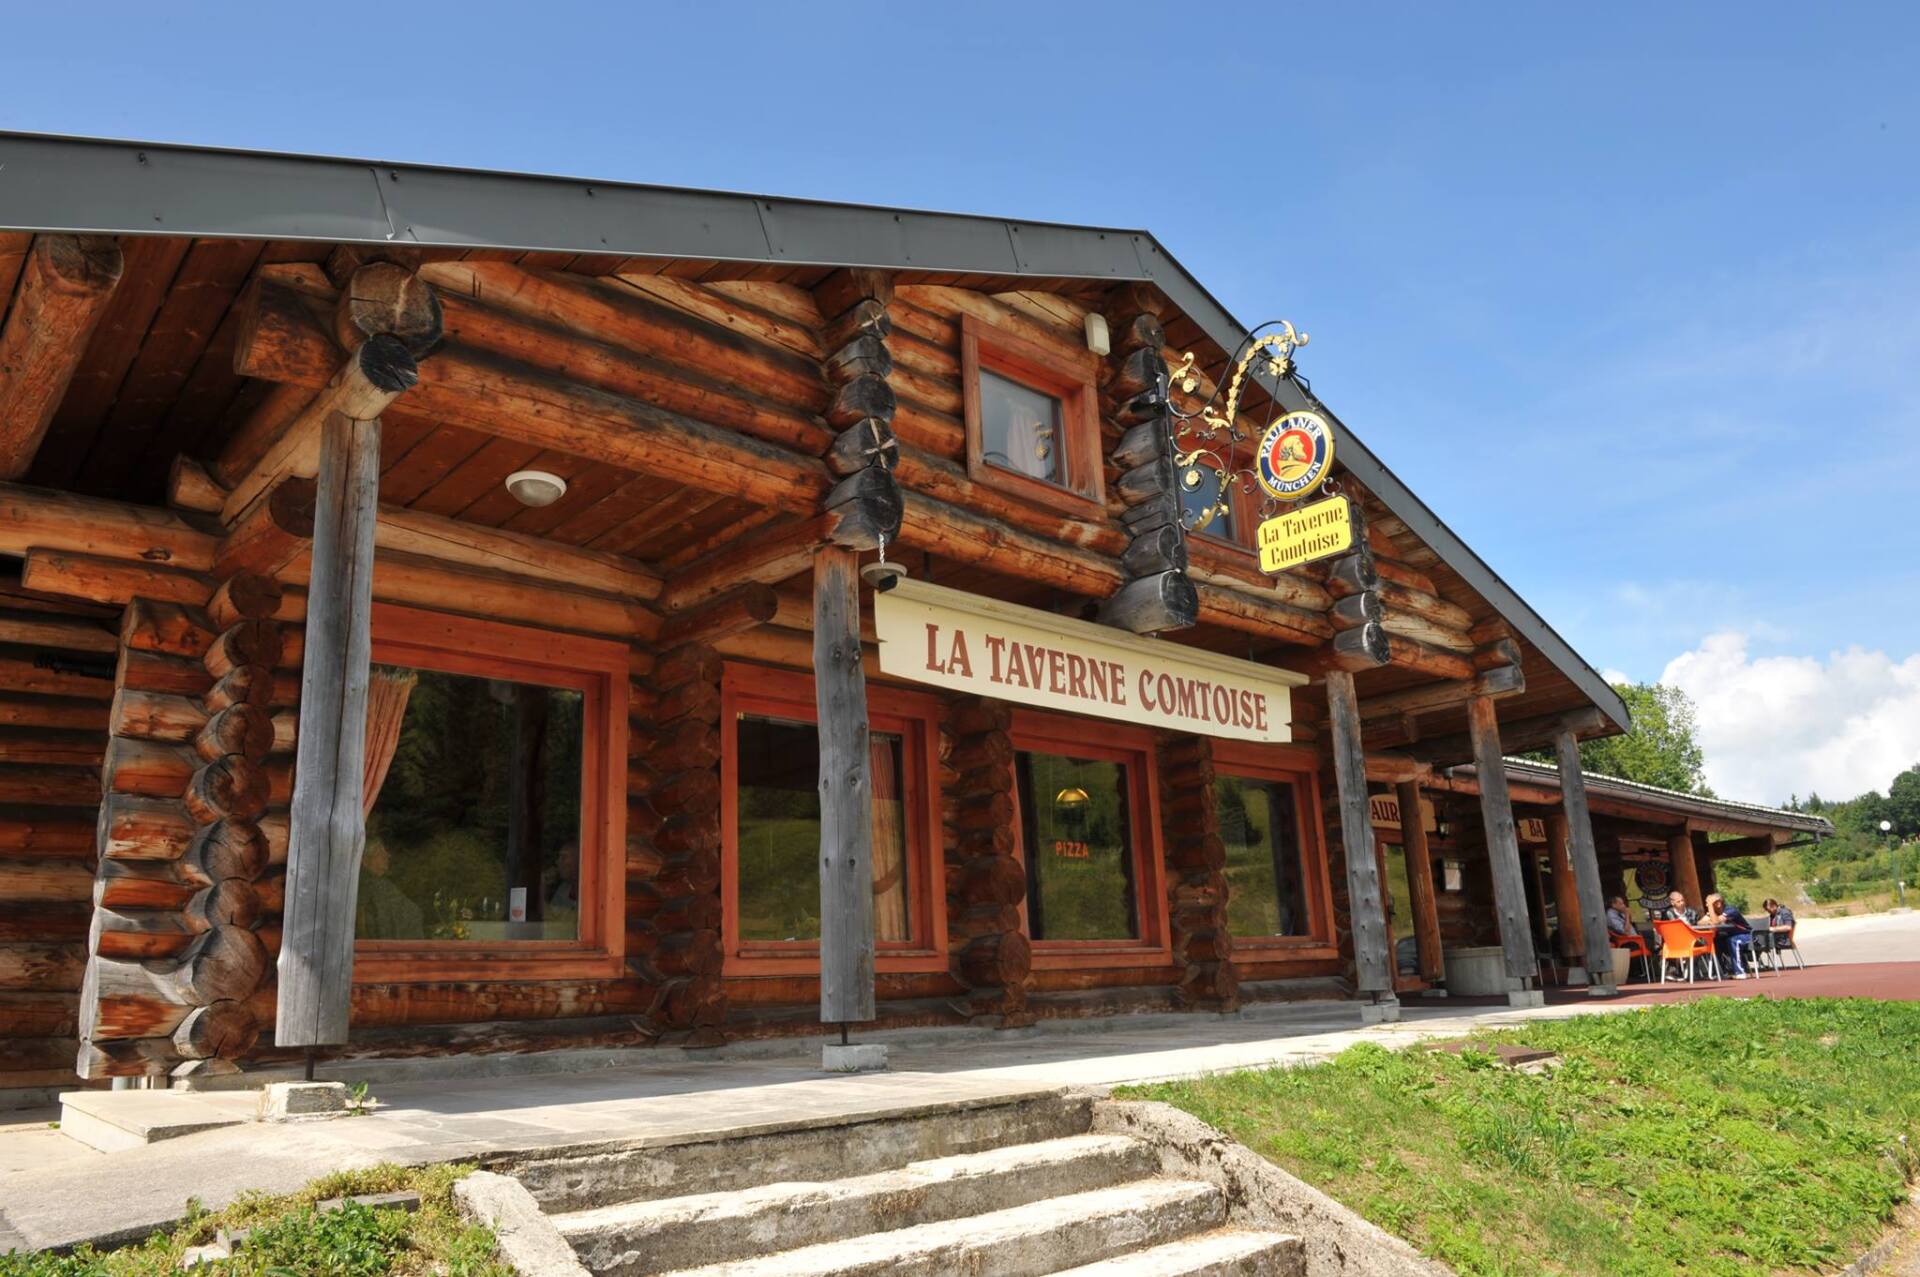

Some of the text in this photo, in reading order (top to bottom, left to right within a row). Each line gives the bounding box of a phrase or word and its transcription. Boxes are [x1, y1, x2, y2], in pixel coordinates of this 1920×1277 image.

[1261, 417, 1321, 458] PAULANER
[1264, 507, 1342, 545] La Taverne
[1271, 532, 1339, 565] Comtoise
[926, 623, 1268, 732] LA TAVERNE COMTOISE
[1055, 841, 1089, 858] PIZZA
